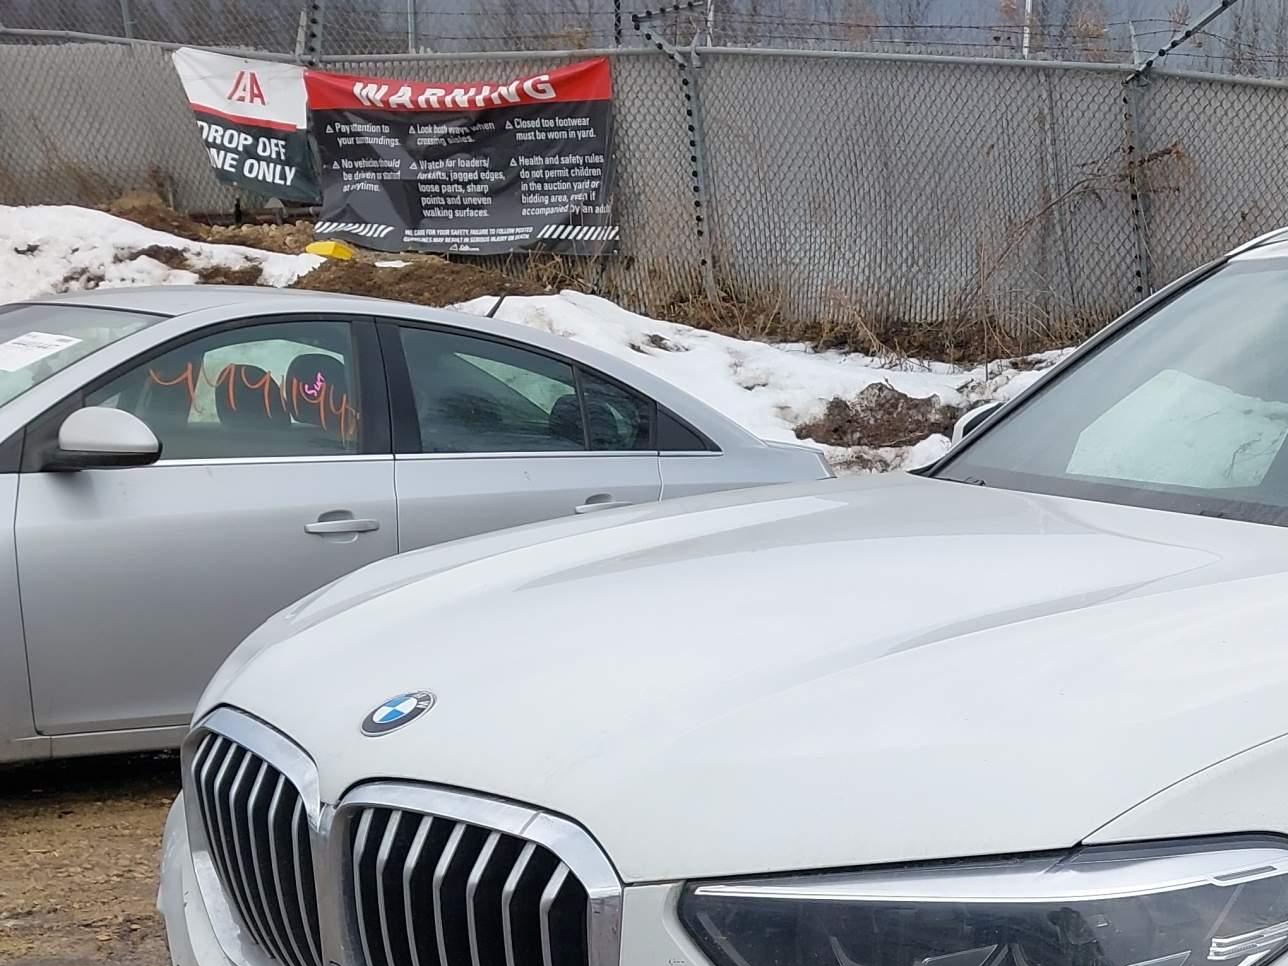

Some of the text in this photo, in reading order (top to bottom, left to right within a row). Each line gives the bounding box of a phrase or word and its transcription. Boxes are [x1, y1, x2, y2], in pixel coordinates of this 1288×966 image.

[353, 75, 556, 108] WARNING
[335, 123, 349, 134] Pay
[382, 124, 390, 133] to
[514, 116, 590, 129] Closed toe footwear
[417, 124, 432, 134] Look
[516, 128, 596, 140] must be worn in yard.
[257, 137, 286, 160] OFF
[338, 137, 354, 148] your
[342, 159, 353, 168] No
[419, 160, 444, 170] Watch
[446, 159, 456, 168] for
[519, 154, 604, 166] Health and safety rules
[244, 158, 296, 186] ONLY
[343, 171, 352, 180] be
[450, 170, 479, 182] jagged
[480, 171, 505, 182] edges,
[520, 167, 601, 179] do not permit children
[418, 182, 489, 194] loose parts, sharp
[521, 180, 600, 191] in the auction yard or
[421, 195, 492, 206] points and uneven
[522, 194, 549, 204] bidding
[590, 191, 596, 201] if
[423, 207, 489, 219] walking surfaces.
[522, 205, 568, 216] accompanied
